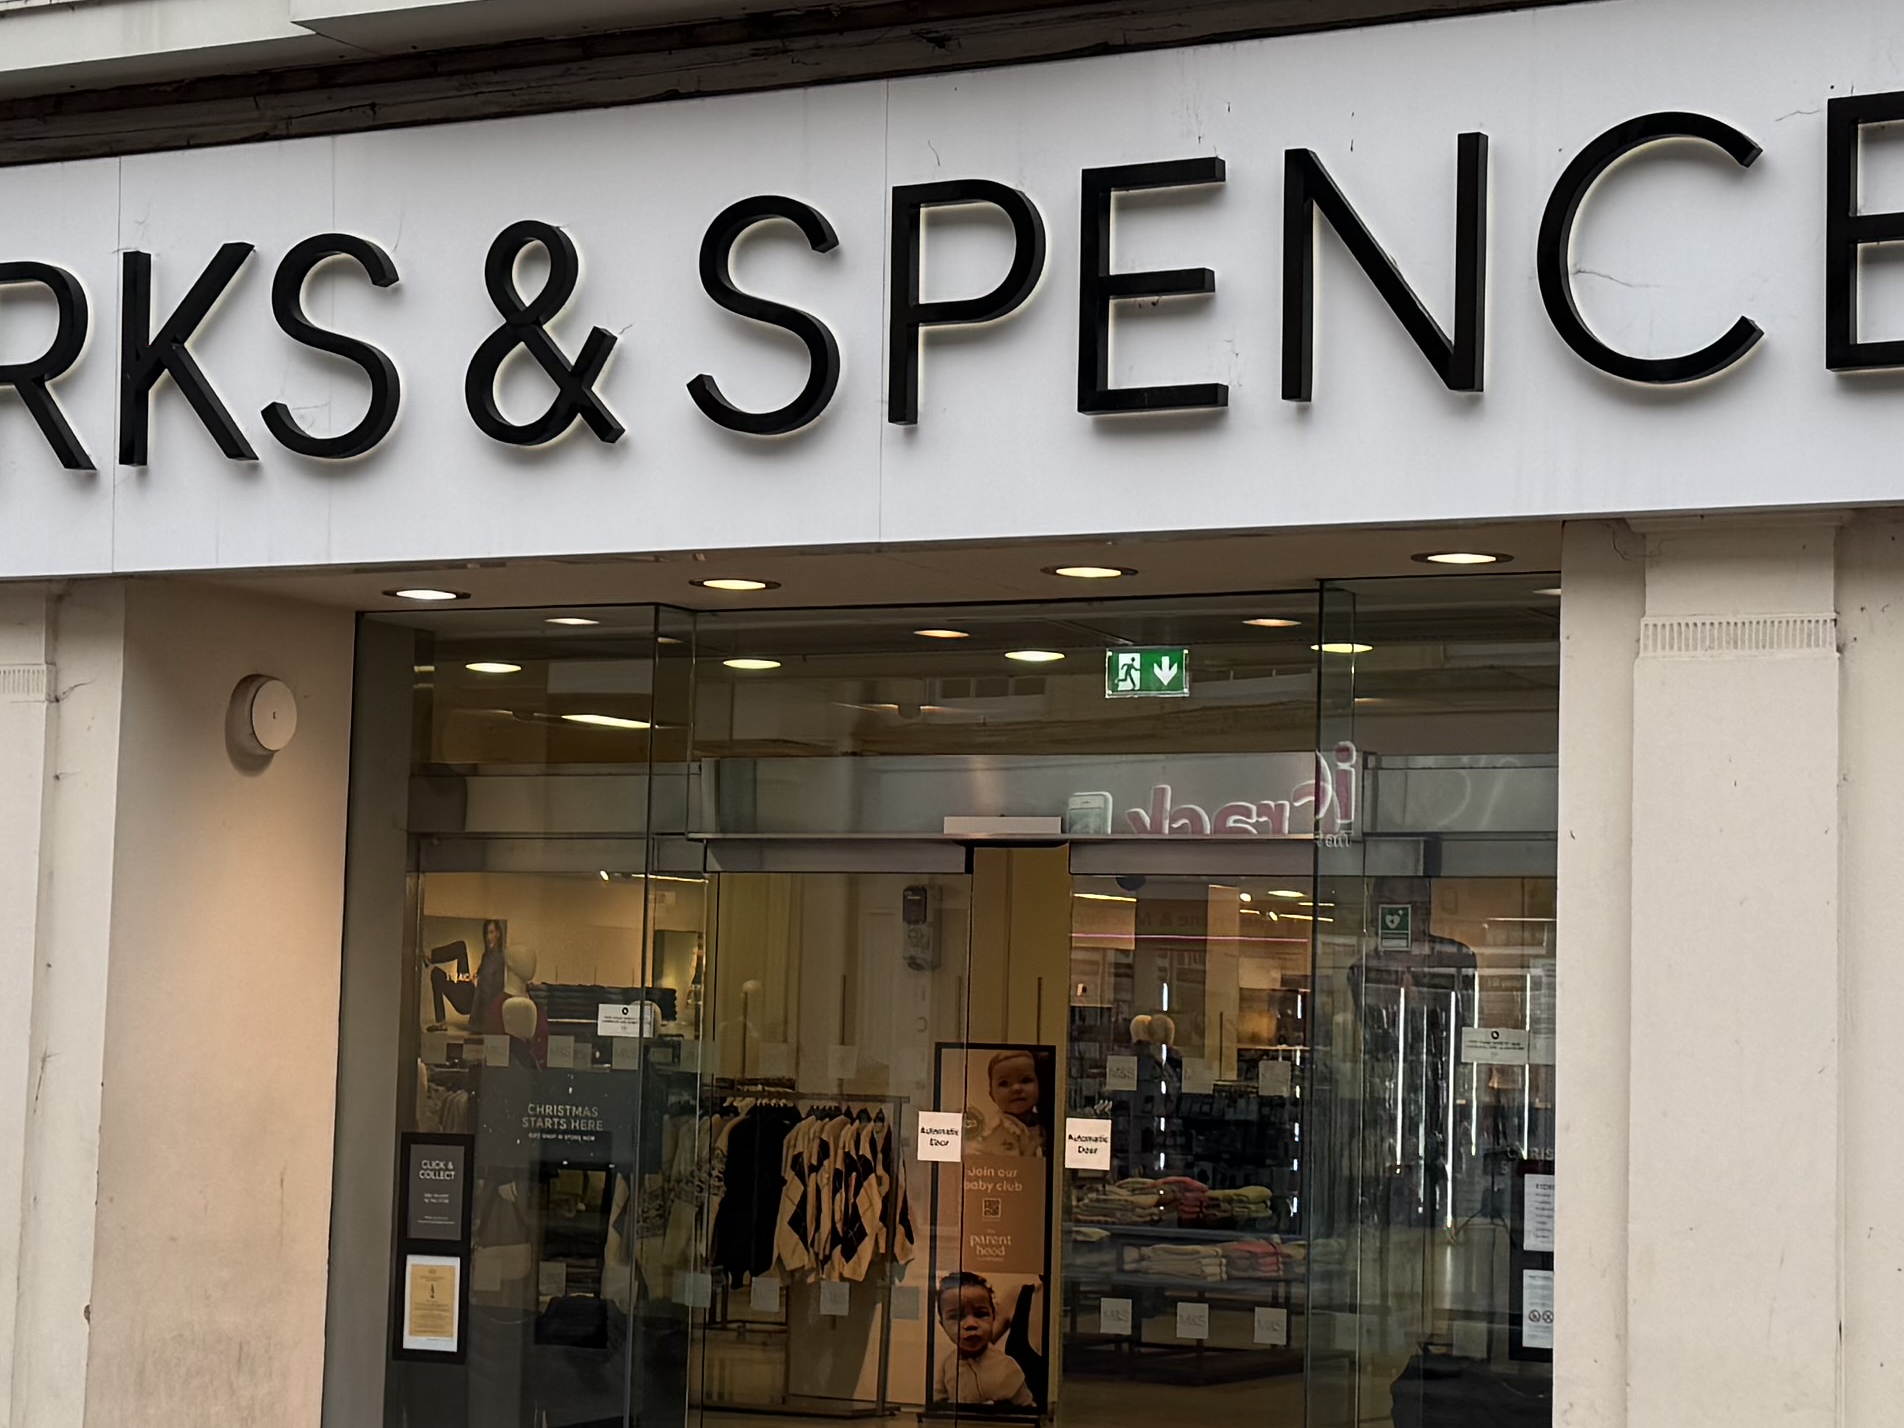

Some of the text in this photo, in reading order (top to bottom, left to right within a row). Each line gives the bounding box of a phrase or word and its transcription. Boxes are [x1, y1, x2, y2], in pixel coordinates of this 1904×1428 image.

[465, 221, 625, 446] &
[527, 1103, 599, 1118] CHRISTMAS
[522, 1117, 604, 1131] STARTS HERE
[920, 1127, 959, 1136] Automatic
[929, 1138, 949, 1147] Door
[1068, 1134, 1109, 1144] Automatic
[1077, 1145, 1098, 1155] Door
[422, 1160, 446, 1170] CLICK
[419, 1170, 455, 1180] COLLECT
[967, 1167, 1019, 1178] Join our
[996, 1181, 1023, 1192] club
[969, 1234, 1012, 1247] parent
[976, 1246, 1006, 1256] hood
